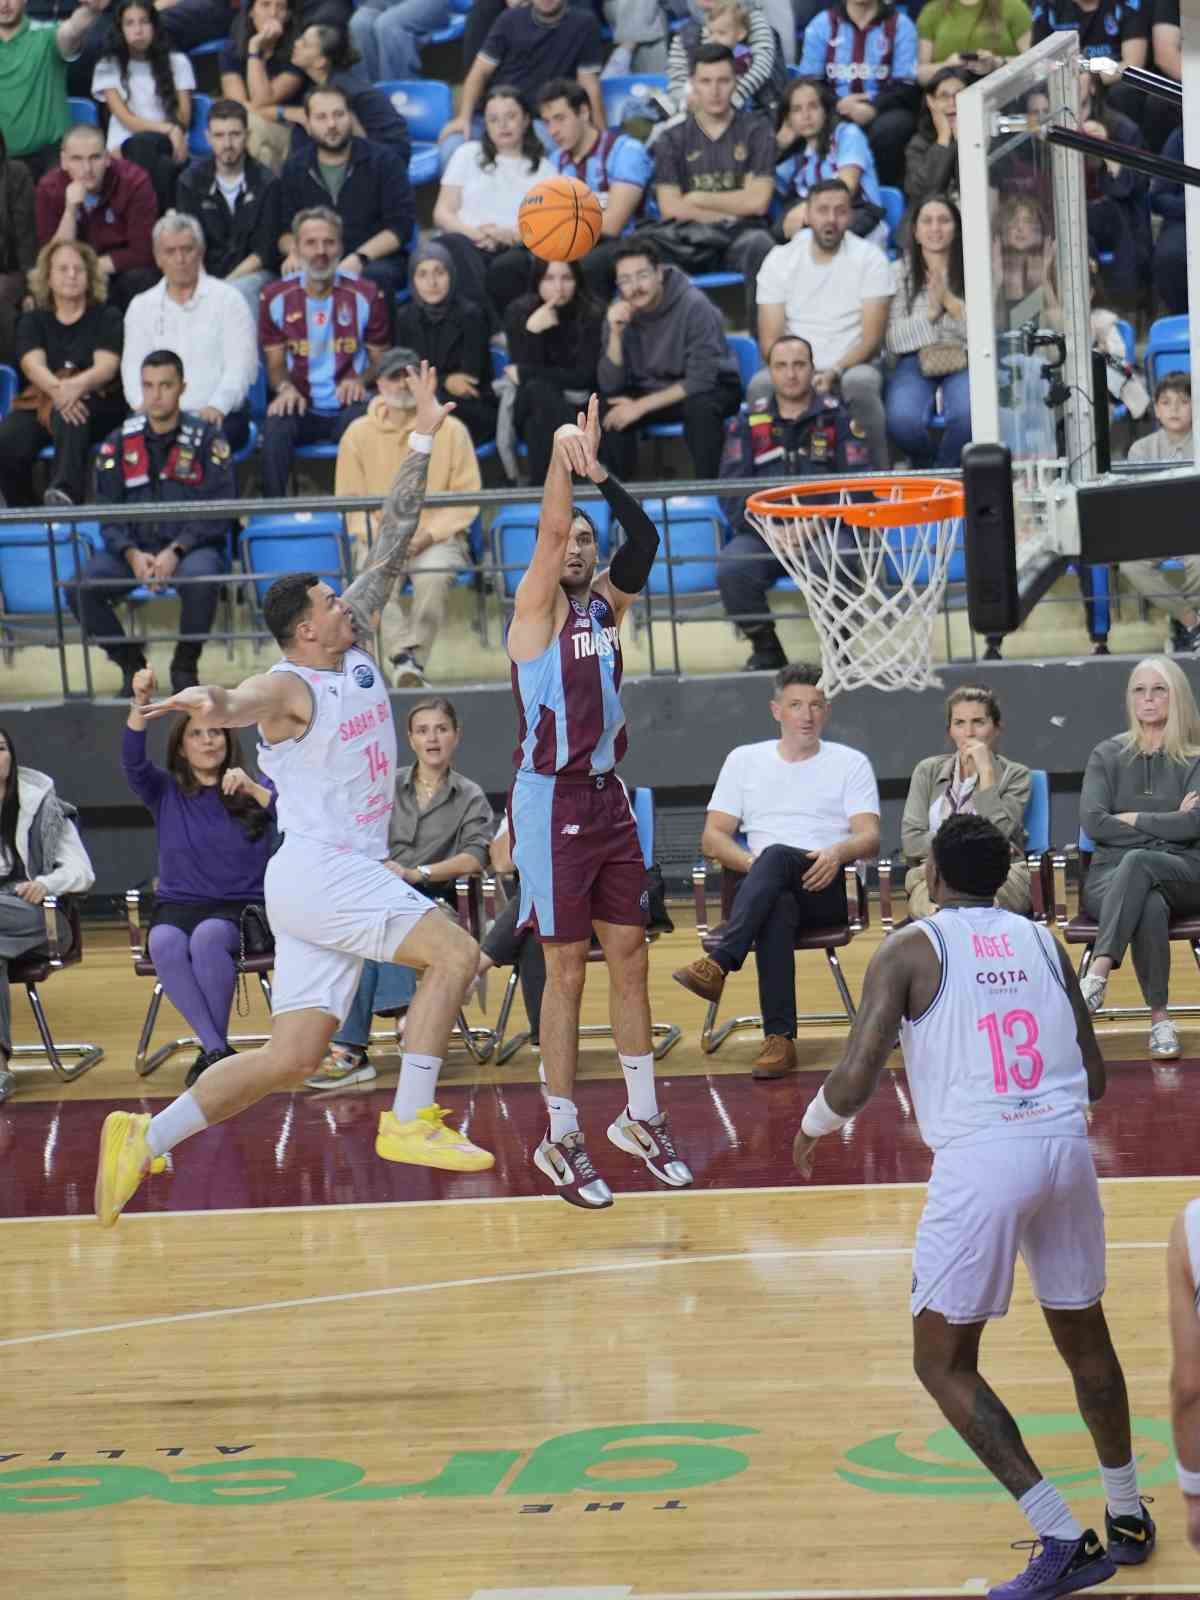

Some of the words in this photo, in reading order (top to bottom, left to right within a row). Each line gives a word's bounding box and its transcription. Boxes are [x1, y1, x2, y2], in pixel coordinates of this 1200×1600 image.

[338, 709, 376, 742] SABAH
[362, 741, 389, 782] 14
[971, 933, 1015, 959] AGEE
[976, 969, 1028, 986] COSTA
[976, 1008, 1044, 1094] 13
[518, 1500, 688, 1514] THE
